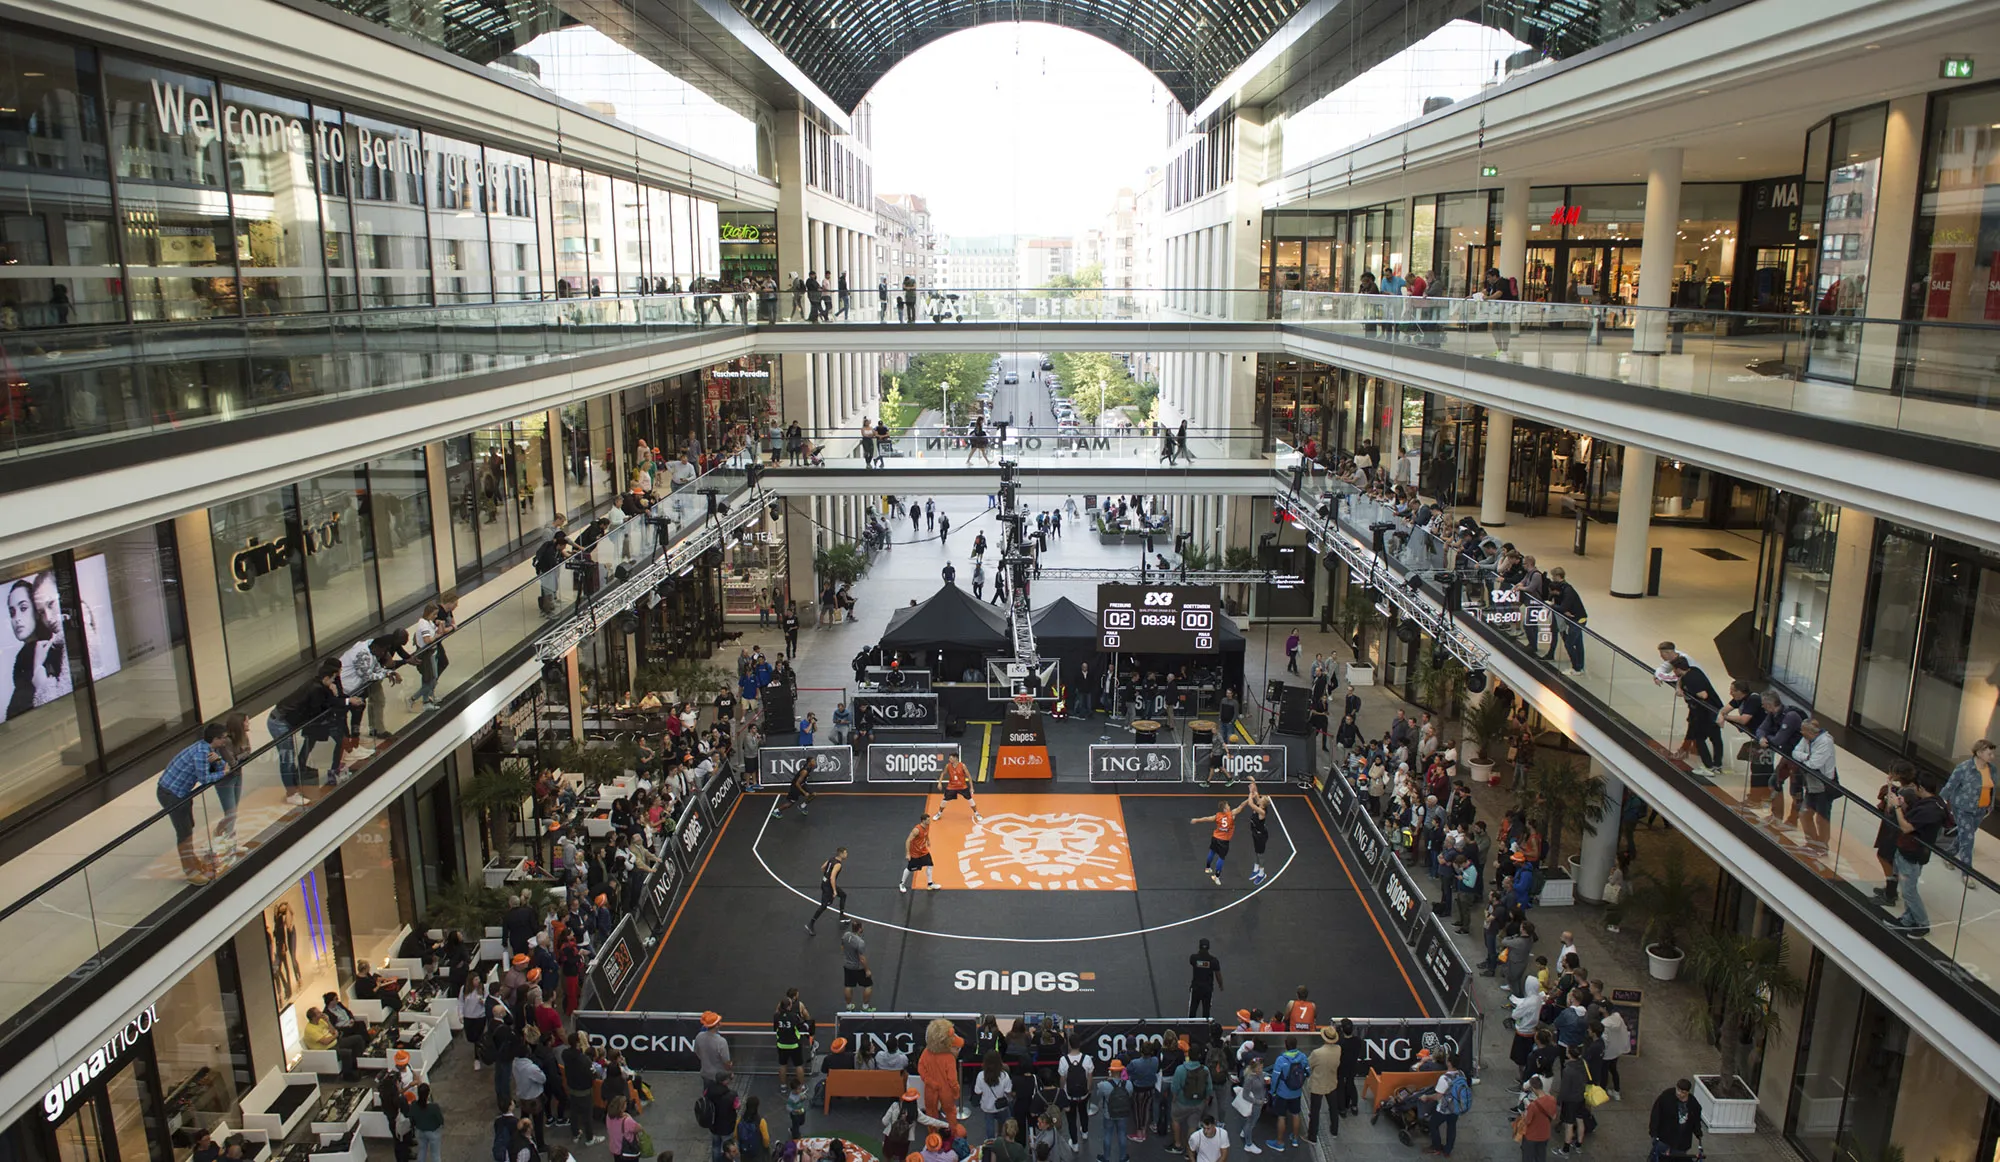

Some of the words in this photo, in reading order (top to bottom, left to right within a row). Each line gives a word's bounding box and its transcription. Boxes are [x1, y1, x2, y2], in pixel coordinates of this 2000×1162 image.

[152, 78, 304, 153] Welcome
[318, 119, 345, 163] to
[1931, 280, 1952, 291] SALE
[712, 370, 739, 378] Taschen
[740, 370, 769, 378] Paradies
[756, 530, 773, 542] TEA
[1109, 613, 1130, 626] 02
[1141, 615, 1176, 626] 09:34
[1186, 614, 1208, 627] 00
[1108, 637, 1116, 645] 0
[1200, 638, 1208, 647] 0
[871, 706, 899, 719] NG
[1009, 732, 1035, 744] snipes
[886, 753, 938, 775] snipes
[1002, 756, 1025, 766] ING
[1100, 756, 1142, 772] ING
[1222, 754, 1264, 776] nipes
[1221, 817, 1228, 828] 5
[1353, 821, 1369, 852] ING
[653, 872, 672, 907] ING
[1386, 872, 1411, 918] snipes
[954, 969, 1080, 995] snipes
[1299, 1006, 1308, 1019] 7
[1363, 1038, 1412, 1061] NG
